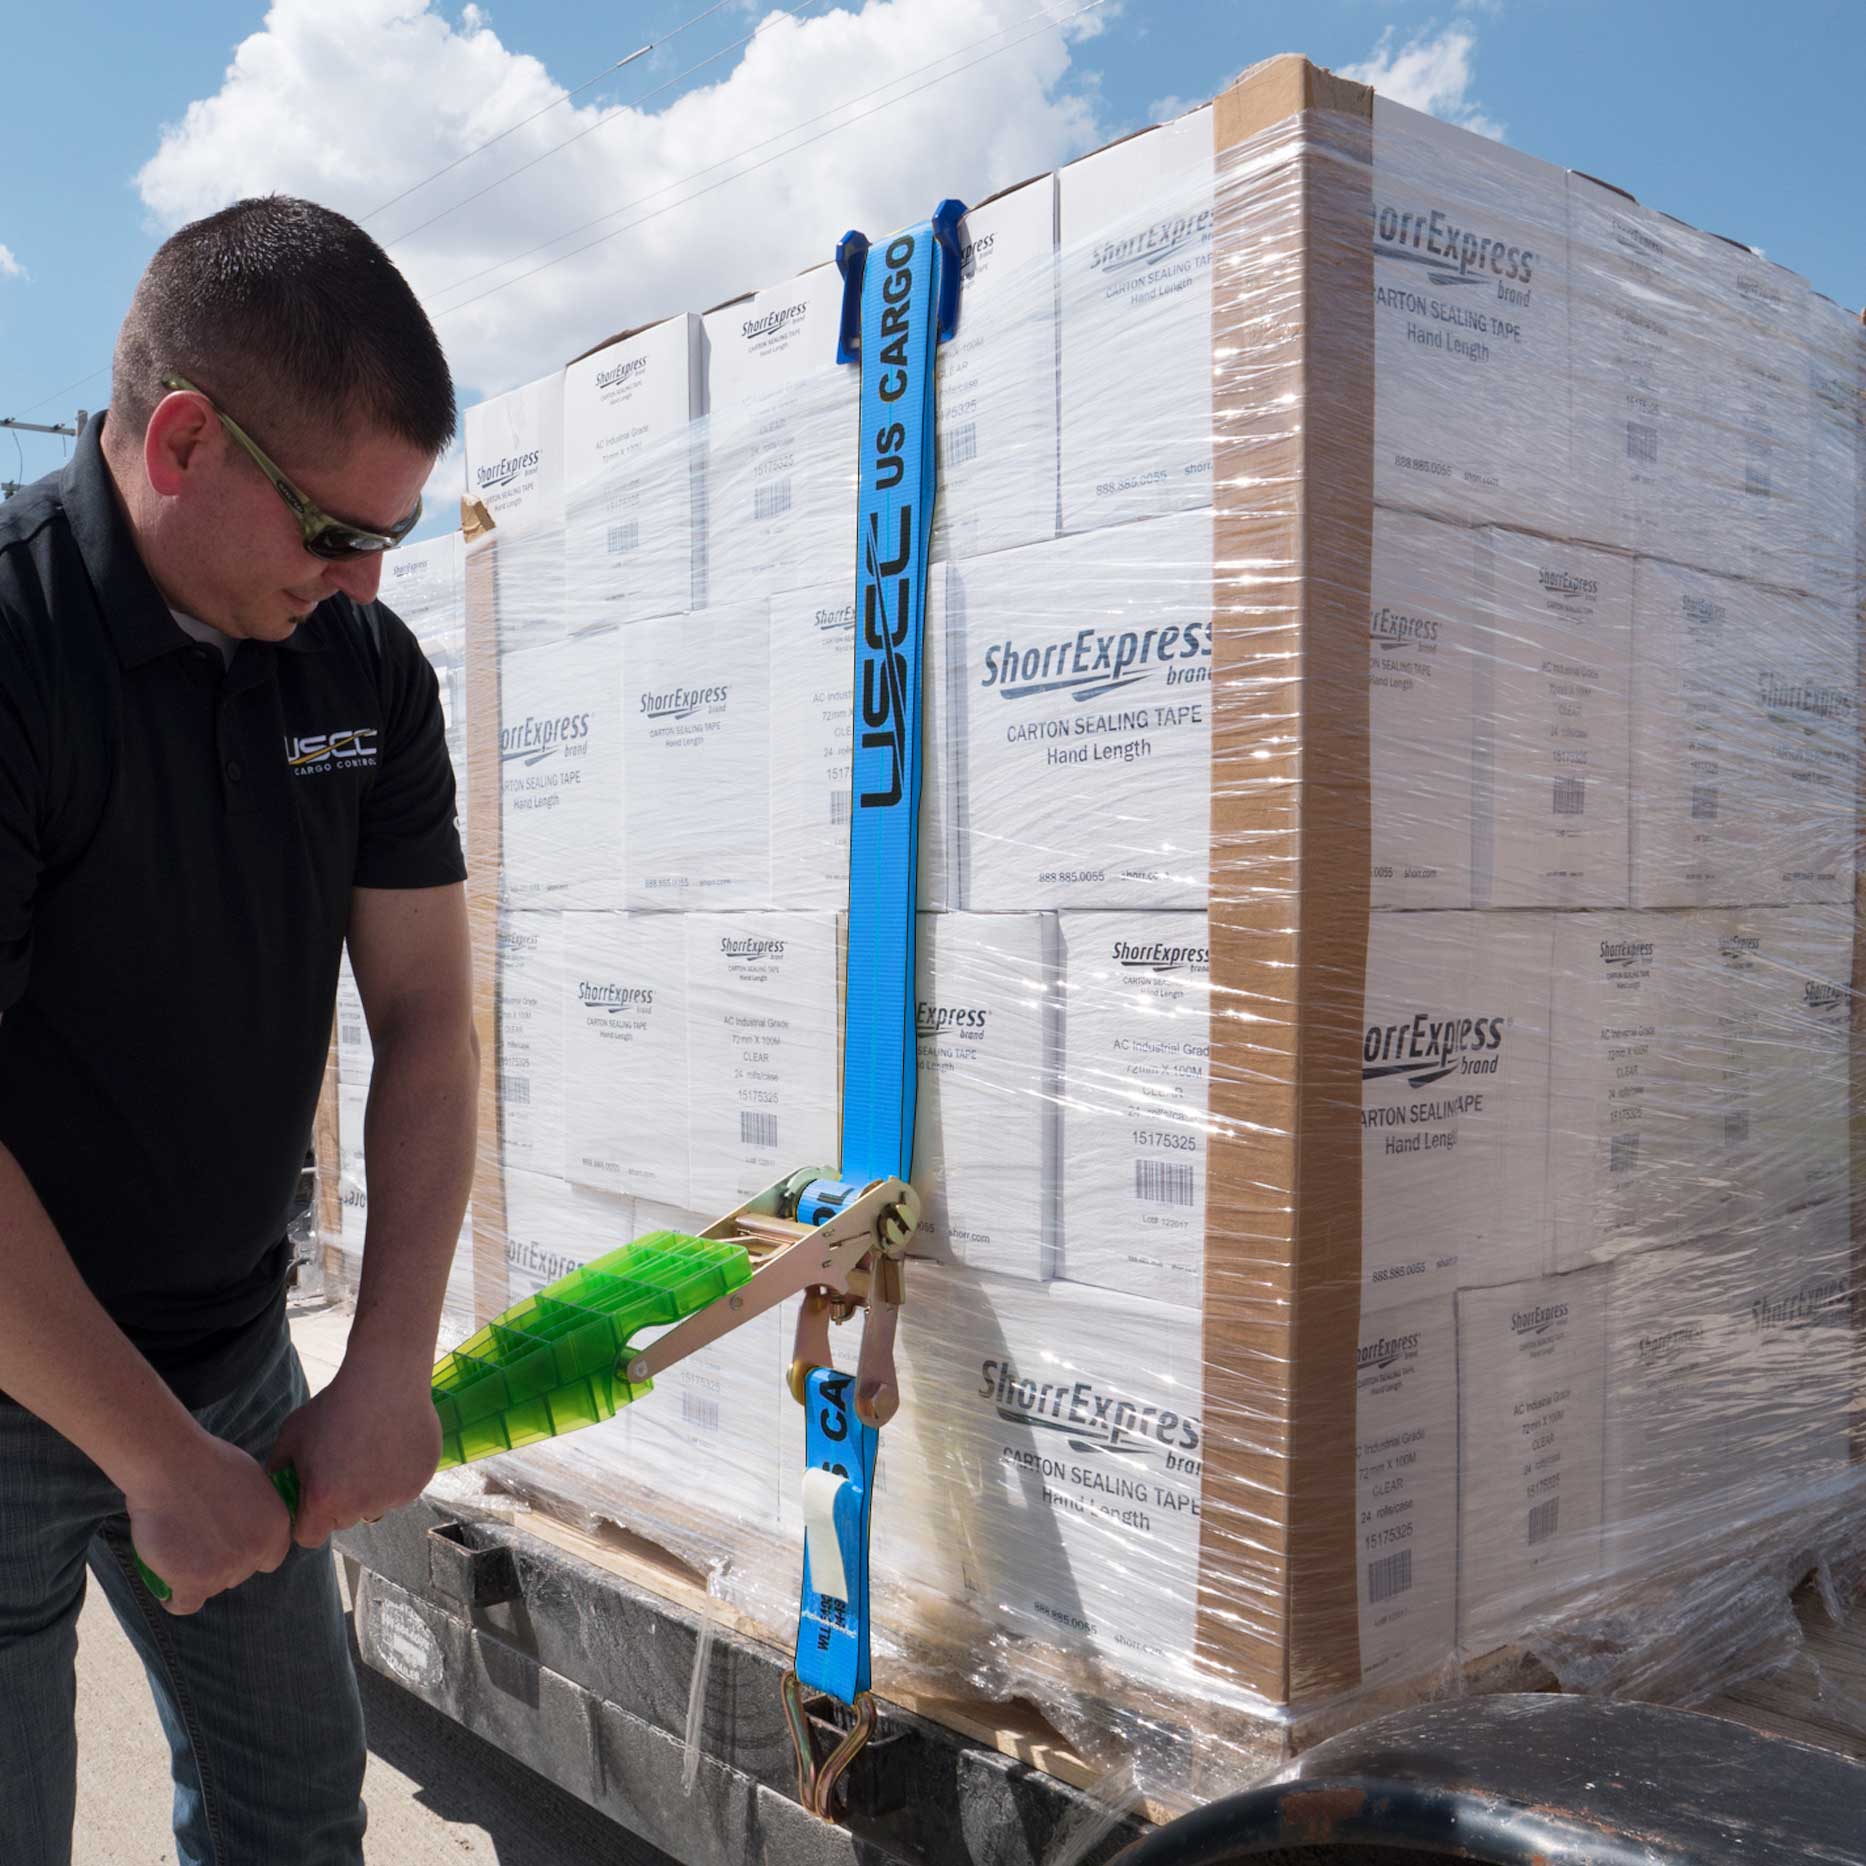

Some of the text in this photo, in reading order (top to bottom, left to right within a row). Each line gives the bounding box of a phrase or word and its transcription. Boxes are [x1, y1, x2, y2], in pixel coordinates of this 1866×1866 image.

[1379, 207, 1534, 283] orrExpress
[1148, 261, 1191, 284] SEALING
[1194, 253, 1213, 268] TAP
[1497, 280, 1531, 307] brand
[741, 300, 807, 336] ShorrExpress
[1376, 287, 1521, 343] ARTON SEALING TAPE
[1407, 321, 1490, 362] Hand Length
[595, 355, 648, 386] ShorrExpress
[875, 234, 916, 491] US CARGO
[477, 449, 541, 484] ShorrExpress
[1184, 461, 1213, 475] shorr.
[814, 605, 855, 627] ShorrE
[1371, 607, 1440, 642] rExpress
[640, 685, 729, 712] ShorrExpress
[500, 713, 590, 753] orrExpress
[1007, 704, 1203, 743] CARTON SEALING TAPE
[1047, 739, 1151, 766] Hand Length
[294, 763, 332, 776] CARGO
[827, 767, 852, 780] 1517
[720, 937, 784, 956] ShorrExpress
[578, 981, 653, 1006] ShorrExpress
[917, 1001, 987, 1031] Express
[960, 1029, 985, 1041] brand
[1113, 1039, 1210, 1057] AC Industrial Grad
[1363, 1013, 1505, 1068] orrExpress
[743, 1051, 769, 1063] CLEAR
[955, 1048, 977, 1060] TAPE
[1461, 1054, 1499, 1075] brand
[1361, 1094, 1484, 1128] ARTON SEALIN APE
[1131, 1131, 1197, 1152] 15175325
[1385, 1127, 1458, 1155] Hand Leng
[507, 1239, 584, 1282] orrExpre
[1356, 1336, 1419, 1363] horrExpress
[979, 1359, 1202, 1450] ShorrExpres
[1165, 1450, 1201, 1476] bra
[1070, 1465, 1148, 1503] SEALING
[1153, 1486, 1201, 1516] TAPE
[1371, 1477, 1405, 1497] CLEAR
[1364, 1521, 1414, 1550] 15175325
[817, 1625, 832, 1651] WLL
